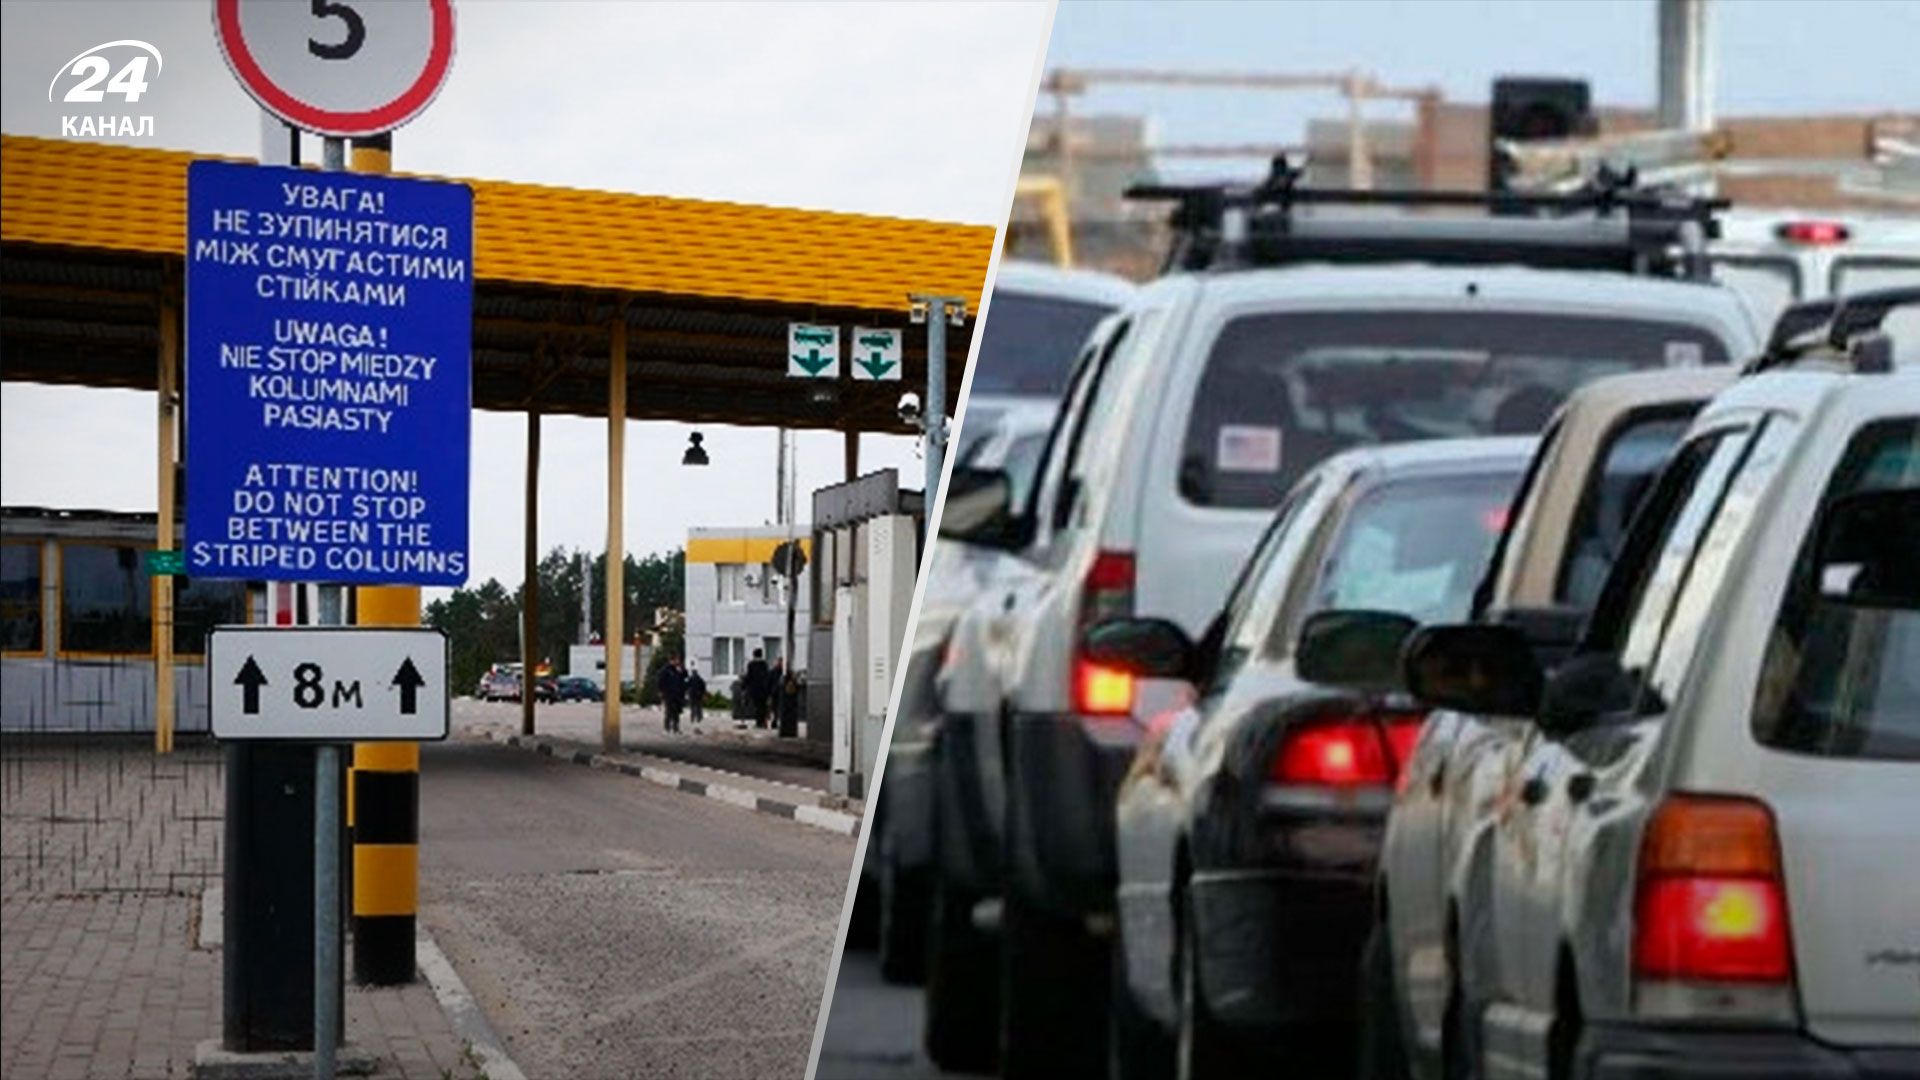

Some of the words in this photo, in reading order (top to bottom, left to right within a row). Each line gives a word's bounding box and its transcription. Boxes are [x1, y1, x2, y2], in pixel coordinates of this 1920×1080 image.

[308, 0, 366, 60] 5
[282, 183, 385, 214] УВАГА!
[213, 209, 250, 235] НЕ
[258, 212, 448, 250] ЗУПИНЯТИСЯ
[195, 239, 260, 266] МІЖ
[266, 244, 465, 283] СМУГАСТИМИ
[256, 271, 405, 307] СТІЙКАМИ
[220, 343, 262, 369] NIE
[267, 346, 337, 374] STOP
[250, 375, 409, 407] KOLUMNAMI
[264, 403, 393, 433] PASIASTY
[244, 464, 418, 493] ATTENTION!
[233, 490, 275, 514] DO
[284, 491, 342, 517] NOT
[352, 494, 426, 520] STOP
[228, 517, 369, 544] BETWEEN
[377, 523, 431, 546] THE
[193, 541, 316, 571] STRIPED
[325, 547, 464, 576] COLUMNS
